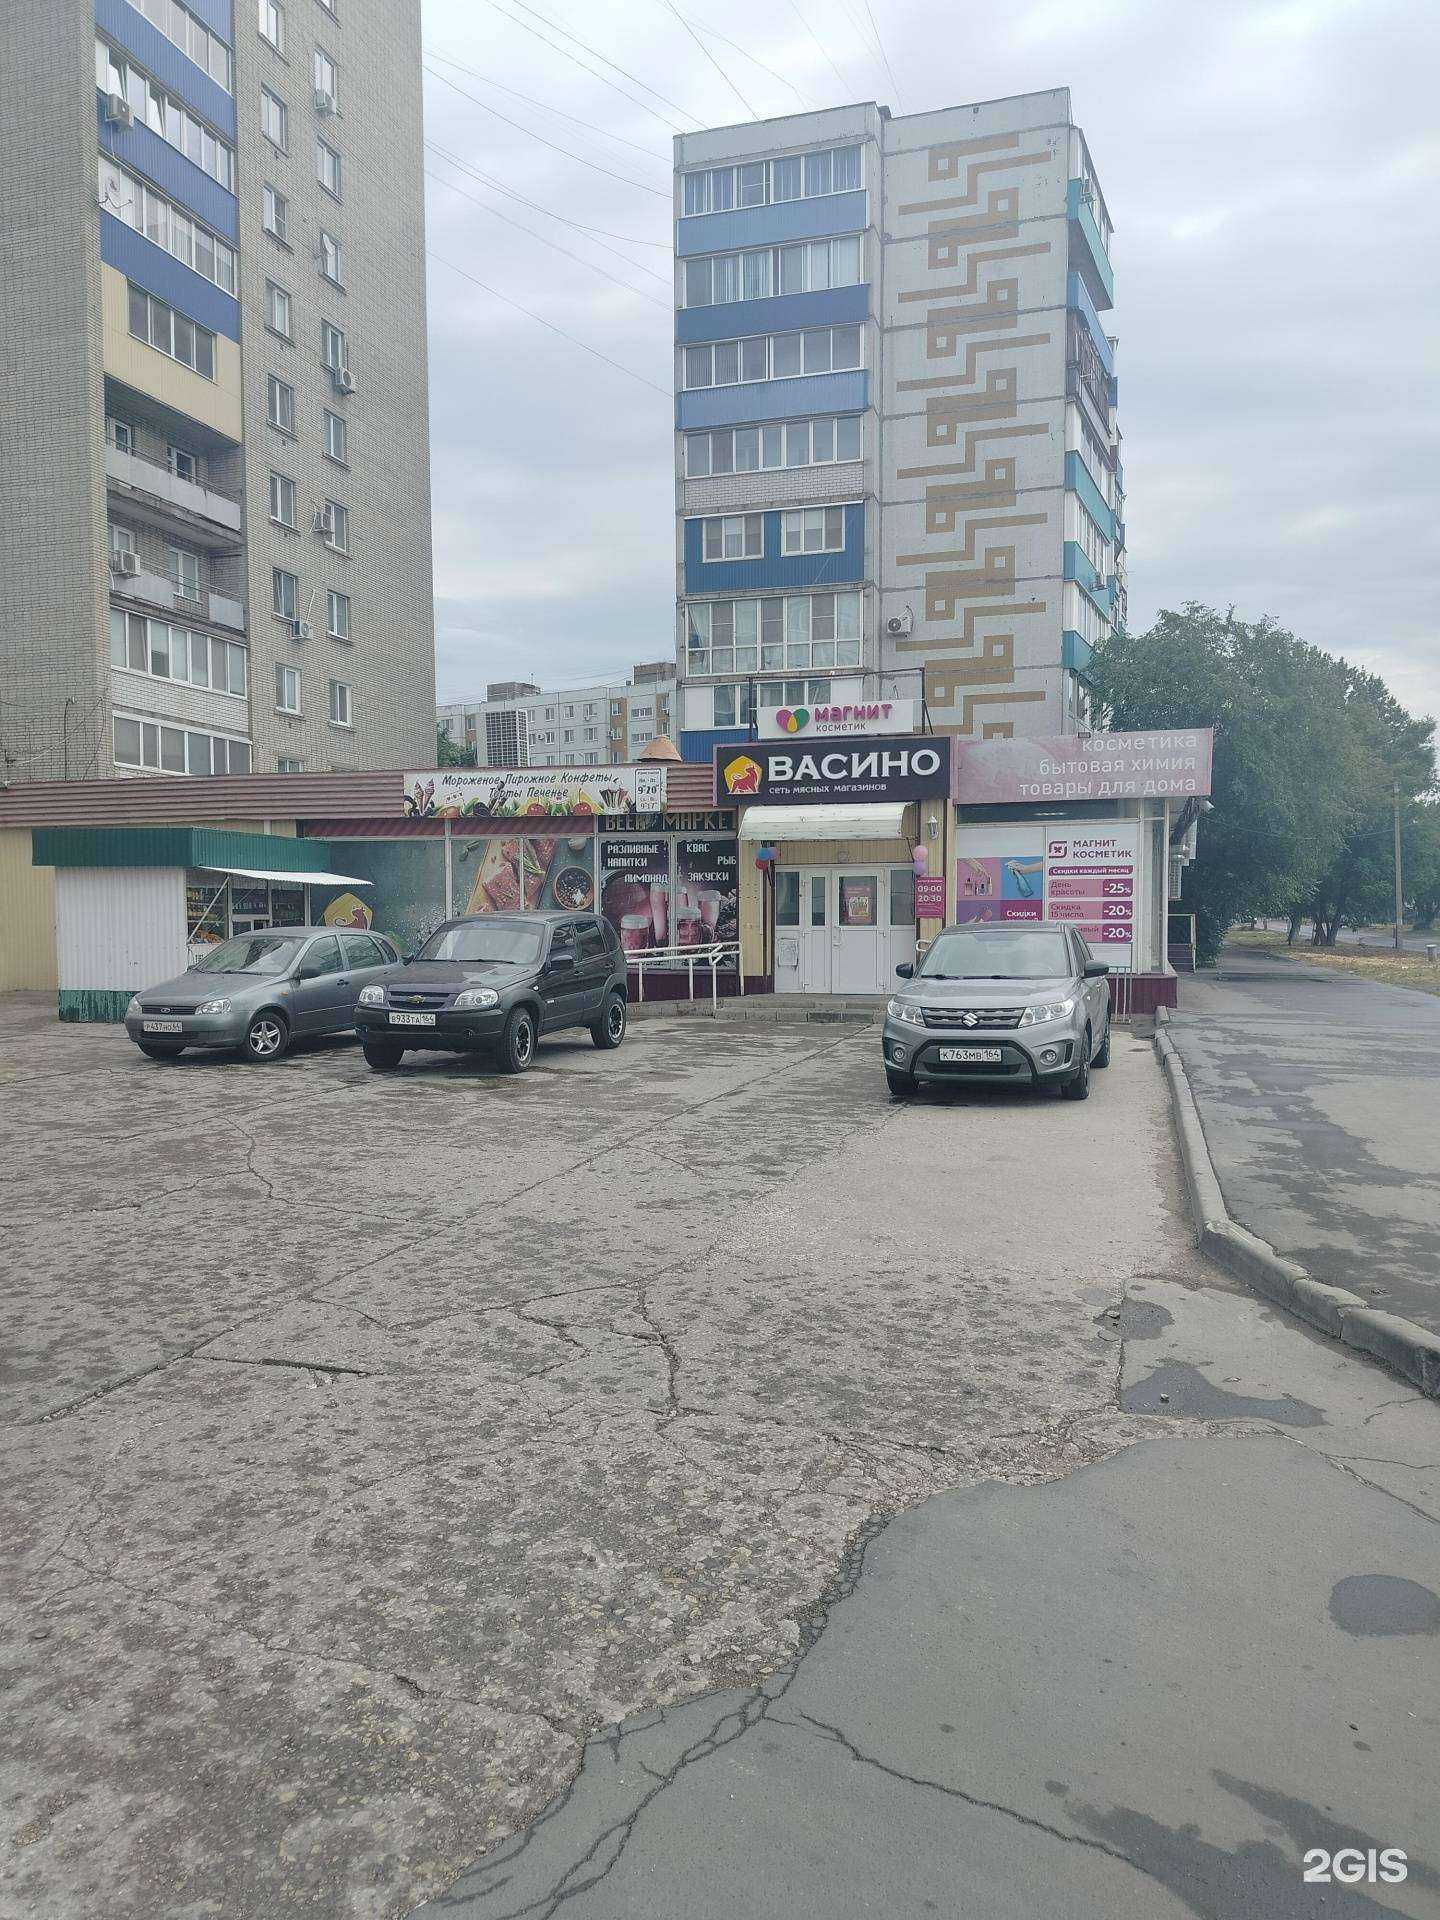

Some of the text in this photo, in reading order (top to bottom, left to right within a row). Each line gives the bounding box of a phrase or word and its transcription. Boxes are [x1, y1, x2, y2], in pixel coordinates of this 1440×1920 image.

[816, 723, 866, 733] косметик
[1082, 735, 1197, 751] косметика
[767, 749, 941, 782] ВАСИНО
[1039, 757, 1195, 775] бытовая химия
[442, 774, 500, 787] Мороженое
[505, 773, 556, 785] Пирожное
[489, 787, 569, 798] Торты Печенье
[769, 783, 887, 795] сеть мясных магазинов
[1020, 778, 1195, 798] товары для дома
[607, 844, 659, 854] РАЗЛИВНЫЕ
[686, 843, 710, 853] КВАС
[1073, 839, 1117, 848] МАГНИТ
[1073, 849, 1132, 859] КОСМЕТИК
[607, 857, 648, 867] НАПИТКИ
[624, 873, 669, 884] ЛИМОНАД
[687, 871, 729, 881] ЗАКУСКИ
[1104, 883, 1132, 894] -25%
[1006, 910, 1037, 918] Скидки
[1103, 905, 1132, 916] -20%
[1103, 927, 1132, 938] -20%
